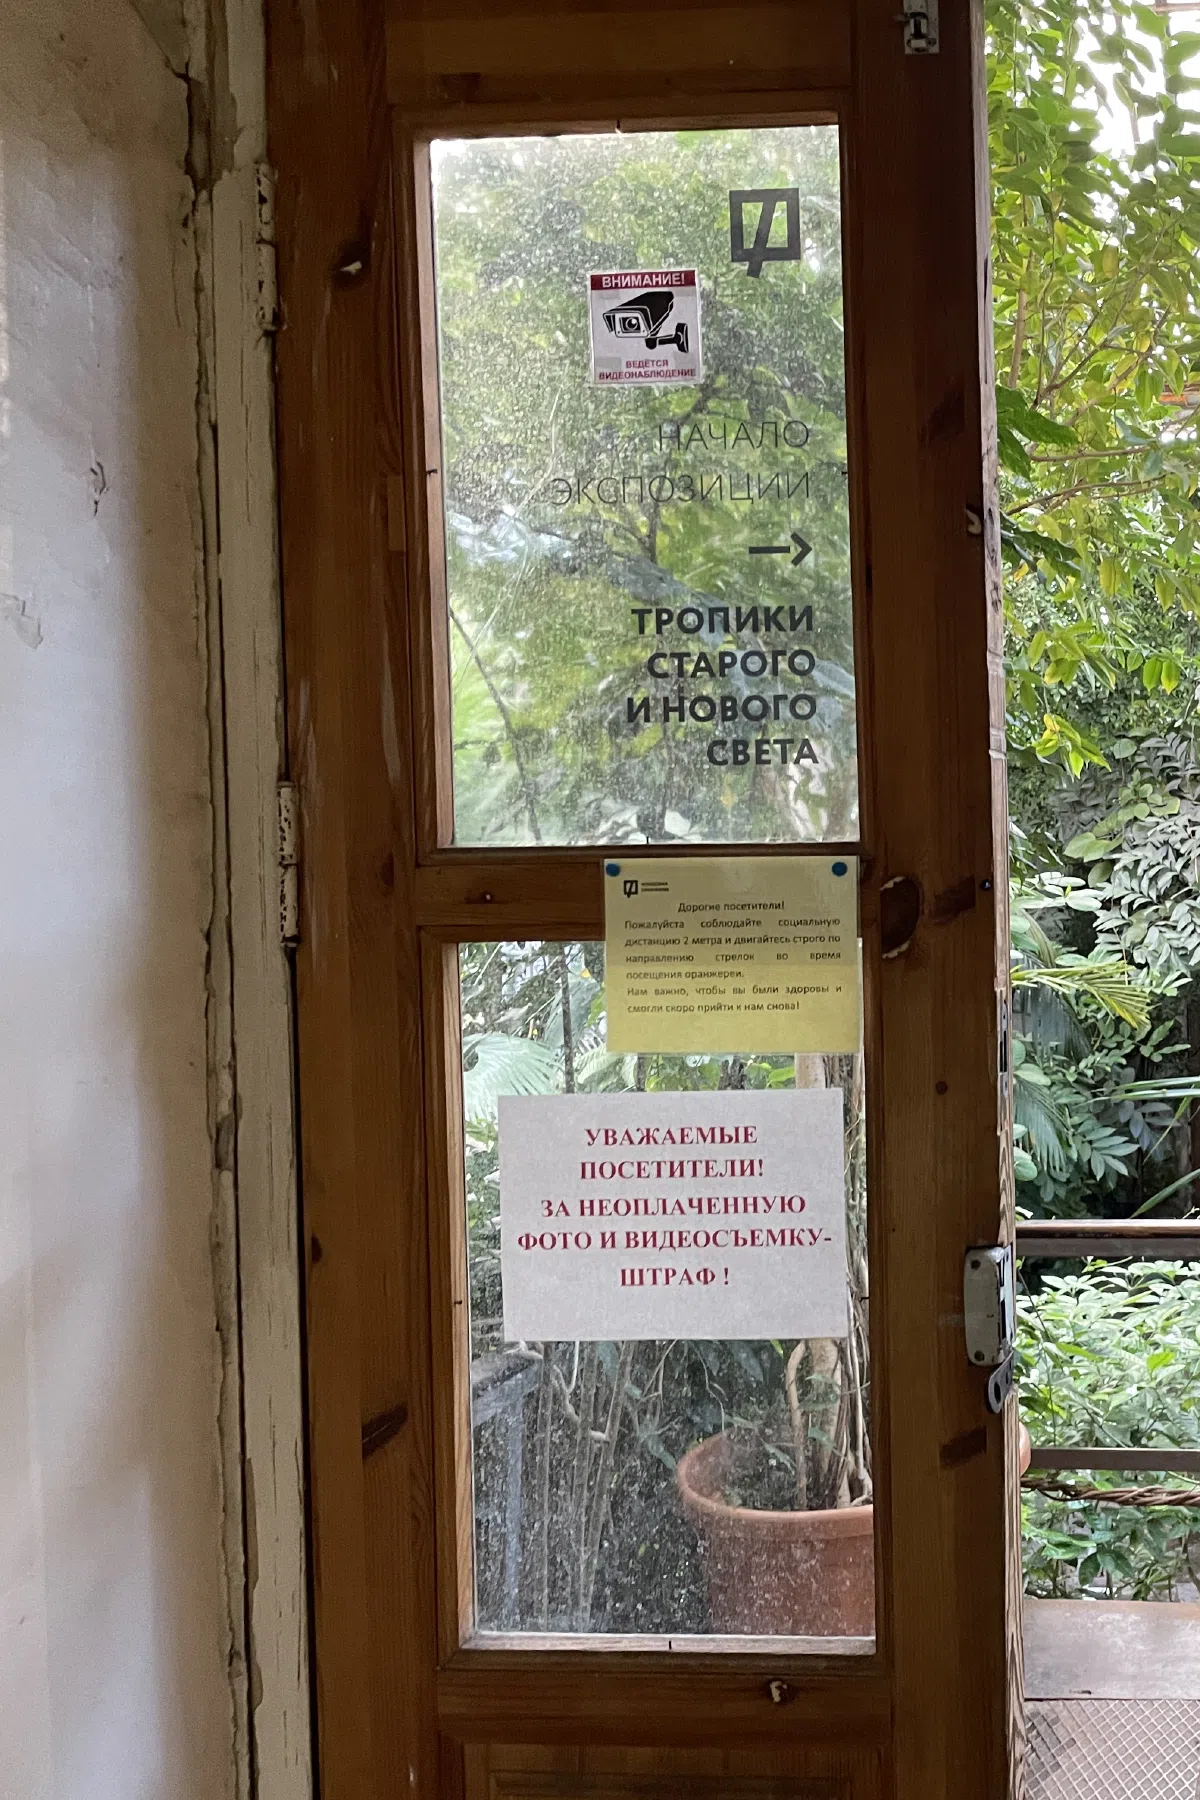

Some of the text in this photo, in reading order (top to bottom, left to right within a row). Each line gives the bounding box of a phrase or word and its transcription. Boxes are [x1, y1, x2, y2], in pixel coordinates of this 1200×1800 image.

[602, 272, 685, 288] ВНИМАНИЕ!
[625, 359, 669, 368] ВЕДЁТСЯ
[598, 368, 696, 381] ВИДЕОНАБЛЮДЕНИЕ
[659, 420, 810, 451] НАЧАЛО
[550, 471, 810, 506] ЭКСПОЗИЦИИ
[631, 605, 814, 635] ТРОПИКИ
[647, 650, 816, 679] СТАРОГО
[627, 694, 818, 723] И НОВОГО
[706, 738, 820, 766] СВЕТА
[677, 901, 785, 913] Дорогие посетители!
[624, 918, 841, 930] Пожалуйста соблюдайте социальную
[624, 934, 841, 947] дистанцию 2 метра и двигайтесь строго по
[625, 952, 841, 964] направлению стрелок во время
[626, 970, 745, 980] посещения оранжереи.
[627, 988, 648, 996] Нам
[654, 987, 689, 997] важно,
[695, 985, 726, 995] чтобы
[732, 986, 746, 995] вы
[752, 984, 779, 994] были
[785, 985, 830, 995] здоровы
[627, 1000, 800, 1013] смогли скоро прийти к нам снова!
[585, 1125, 758, 1147] УВАЖАЕМЫЕ
[580, 1158, 765, 1180] ПОСЕТИТЕЛИ!
[541, 1195, 807, 1218] ЗА НЕОПЛАЧЕННУЮ
[517, 1227, 833, 1252] ФОТО И ВИДЕОСЪЕМКУ-
